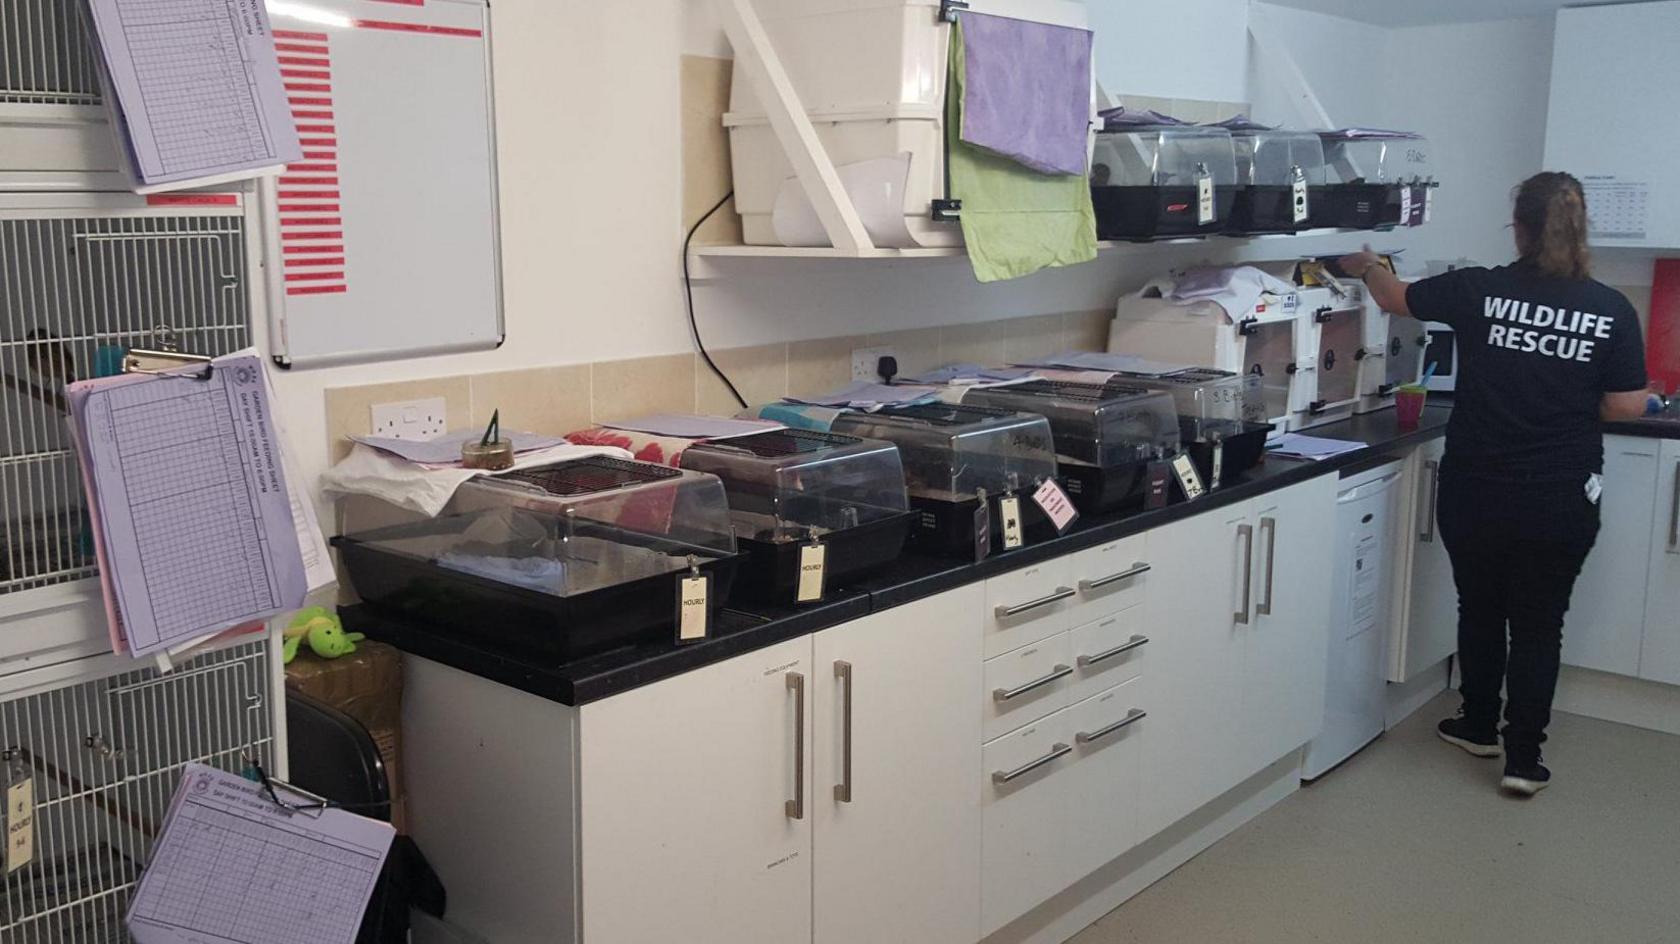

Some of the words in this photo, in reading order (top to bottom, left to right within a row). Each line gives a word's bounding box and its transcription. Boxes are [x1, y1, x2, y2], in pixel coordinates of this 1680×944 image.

[1483, 296, 1614, 338] WILDLIFE
[1487, 324, 1595, 362] RESCUE
[252, 390, 263, 420] GARDEN
[243, 408, 254, 427] SHIFT
[259, 421, 267, 438] BIRD
[262, 438, 275, 470] FEEDING
[268, 470, 280, 493] SHEET
[802, 564, 822, 572] HOURLY
[683, 598, 705, 607] HOURLY
